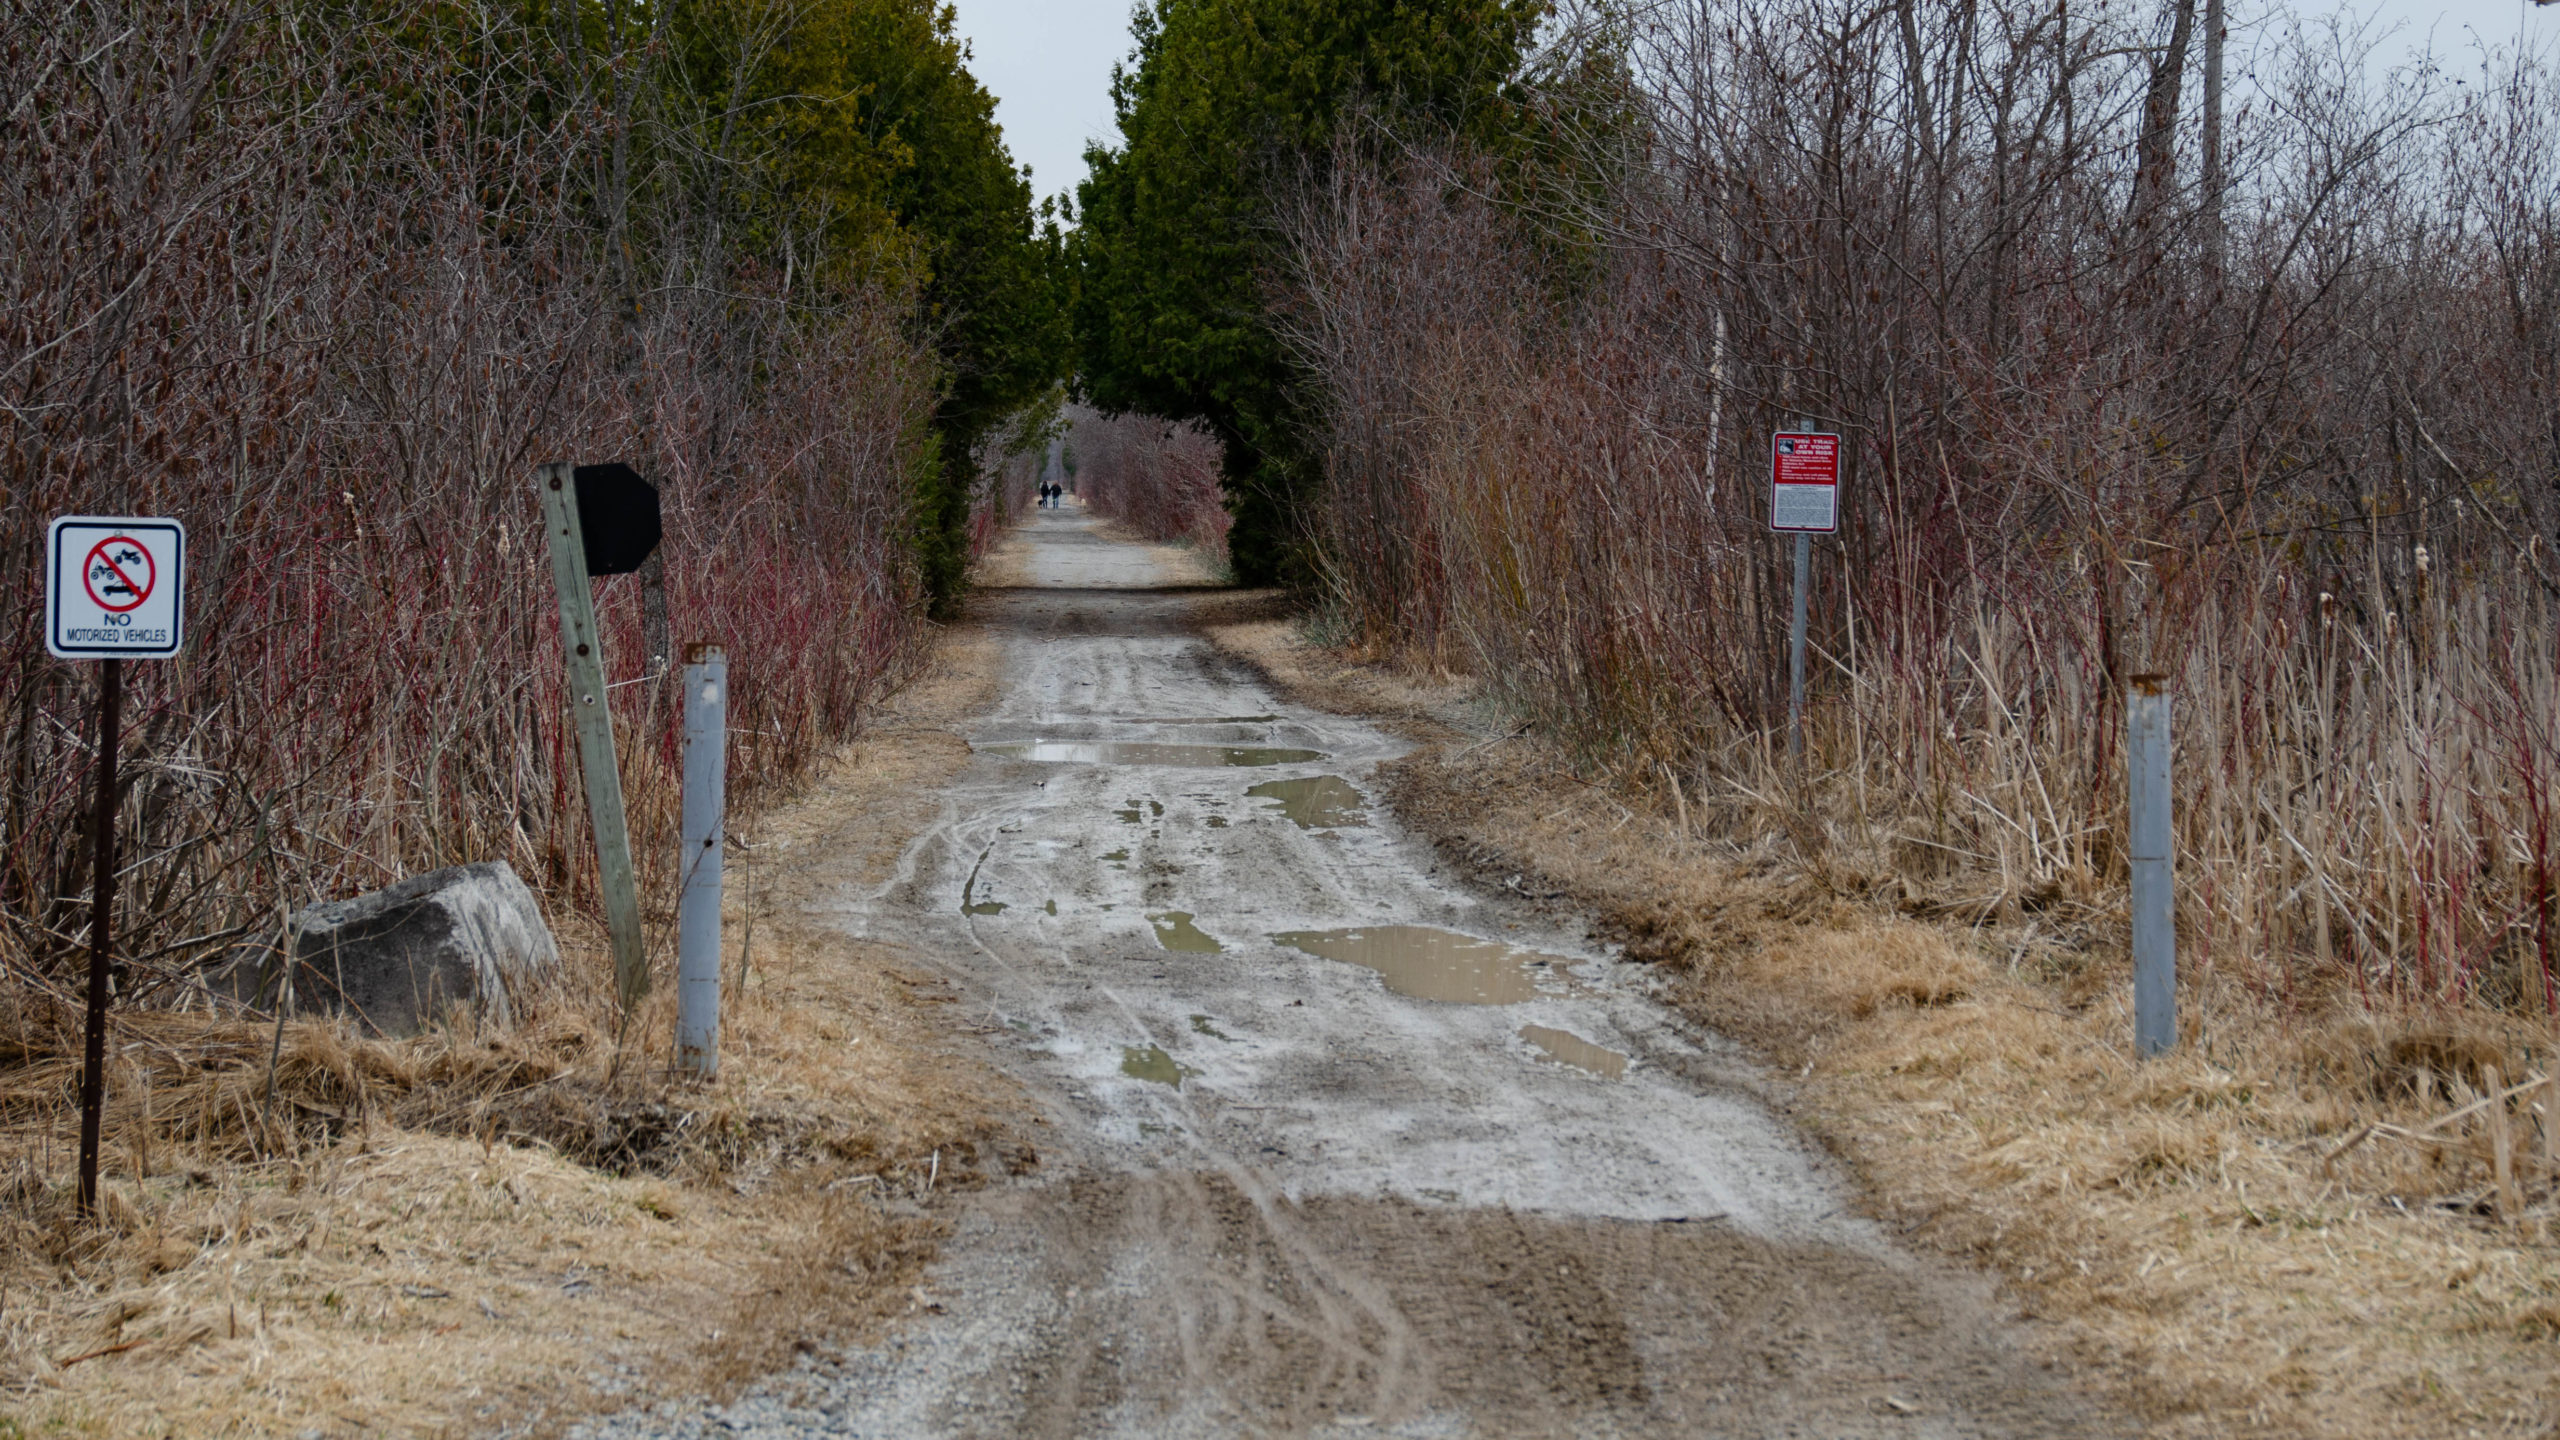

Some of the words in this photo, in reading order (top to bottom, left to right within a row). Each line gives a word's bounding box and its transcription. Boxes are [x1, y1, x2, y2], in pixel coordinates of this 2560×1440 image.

[104, 613, 131, 626] NO
[67, 628, 120, 643] MOTORIZED
[123, 629, 166, 642] VEHICLES
